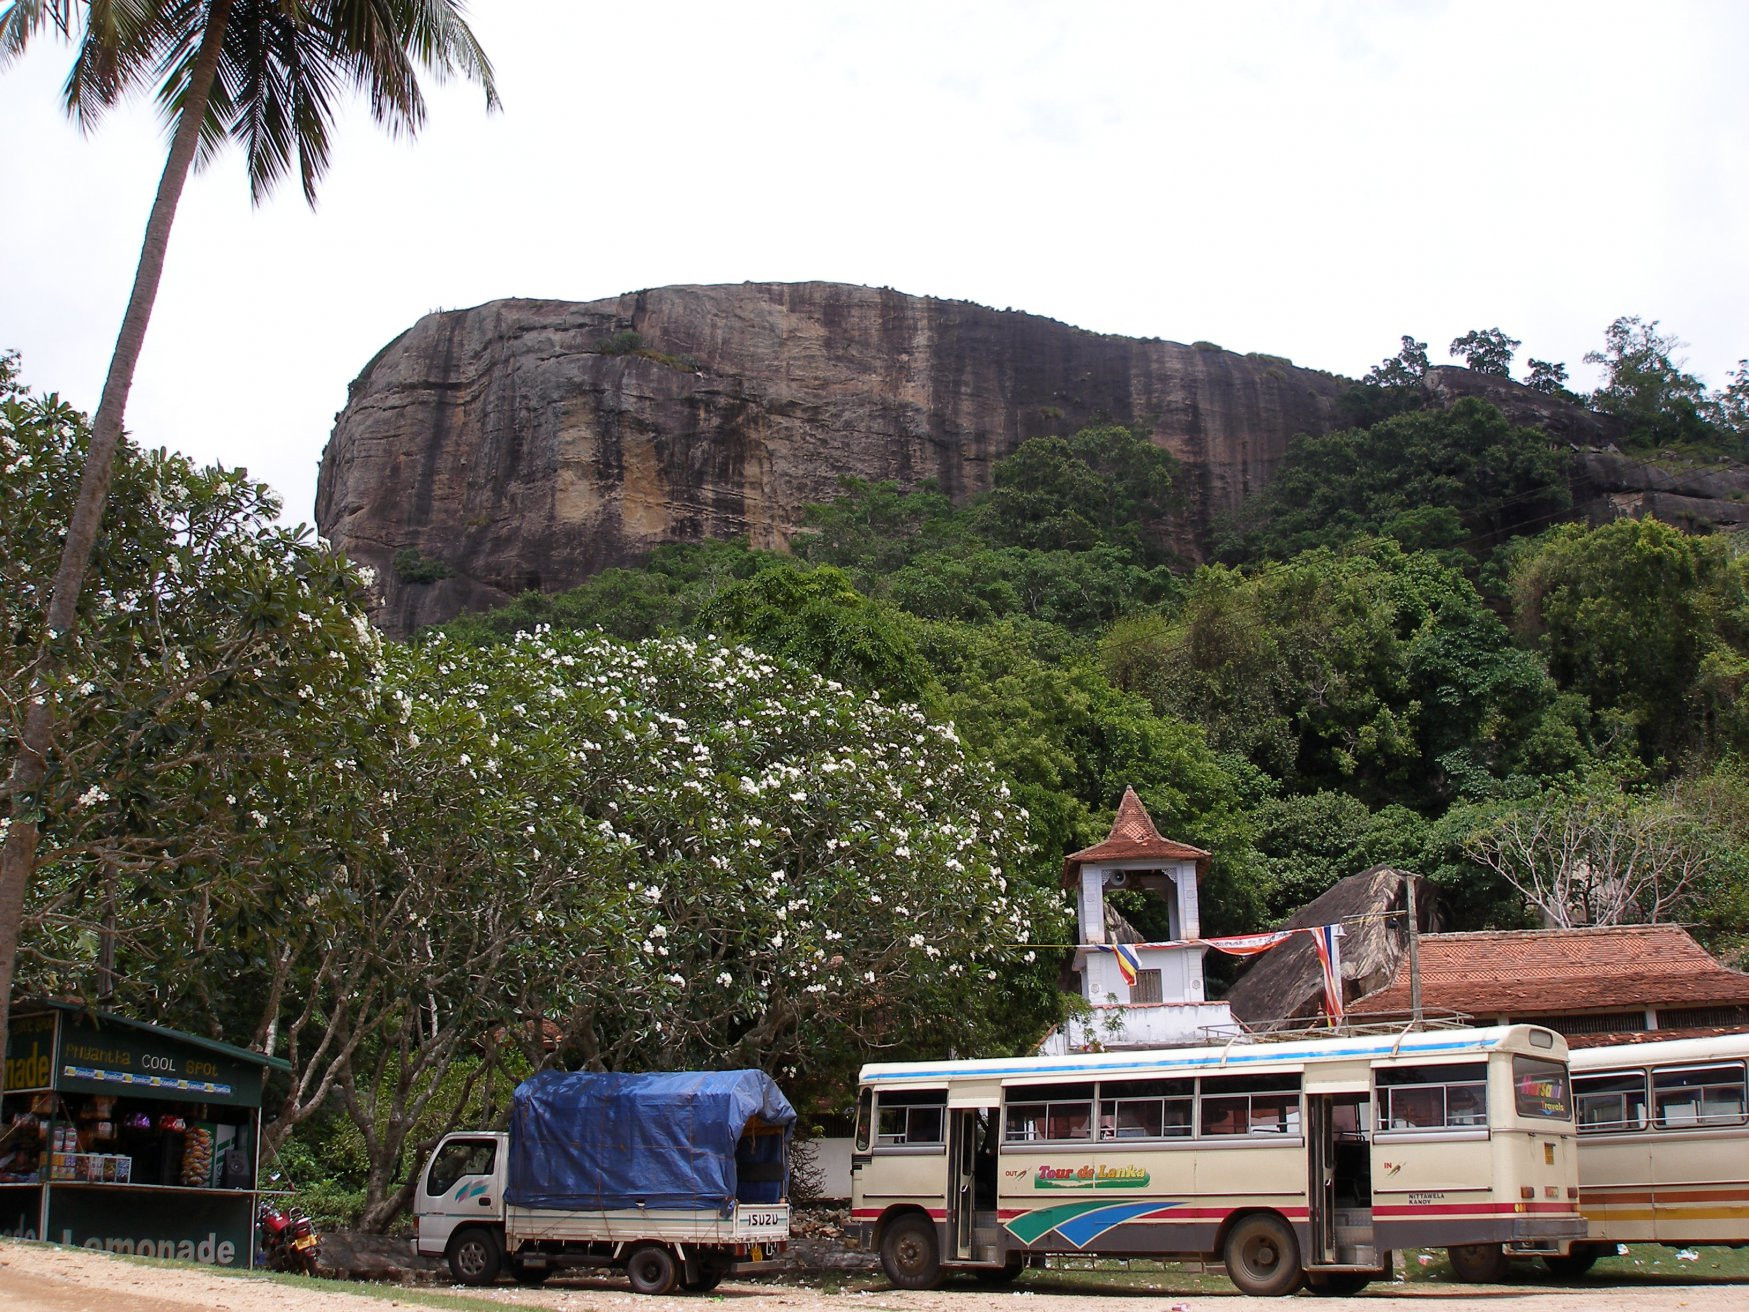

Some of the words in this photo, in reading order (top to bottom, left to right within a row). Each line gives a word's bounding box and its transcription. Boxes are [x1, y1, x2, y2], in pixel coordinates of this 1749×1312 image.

[142, 1054, 176, 1072] COOL
[1039, 1165, 1073, 1179] Tour
[1077, 1165, 1095, 1179] de
[1098, 1164, 1145, 1178] Lanka
[748, 1214, 778, 1226] ISUZU
